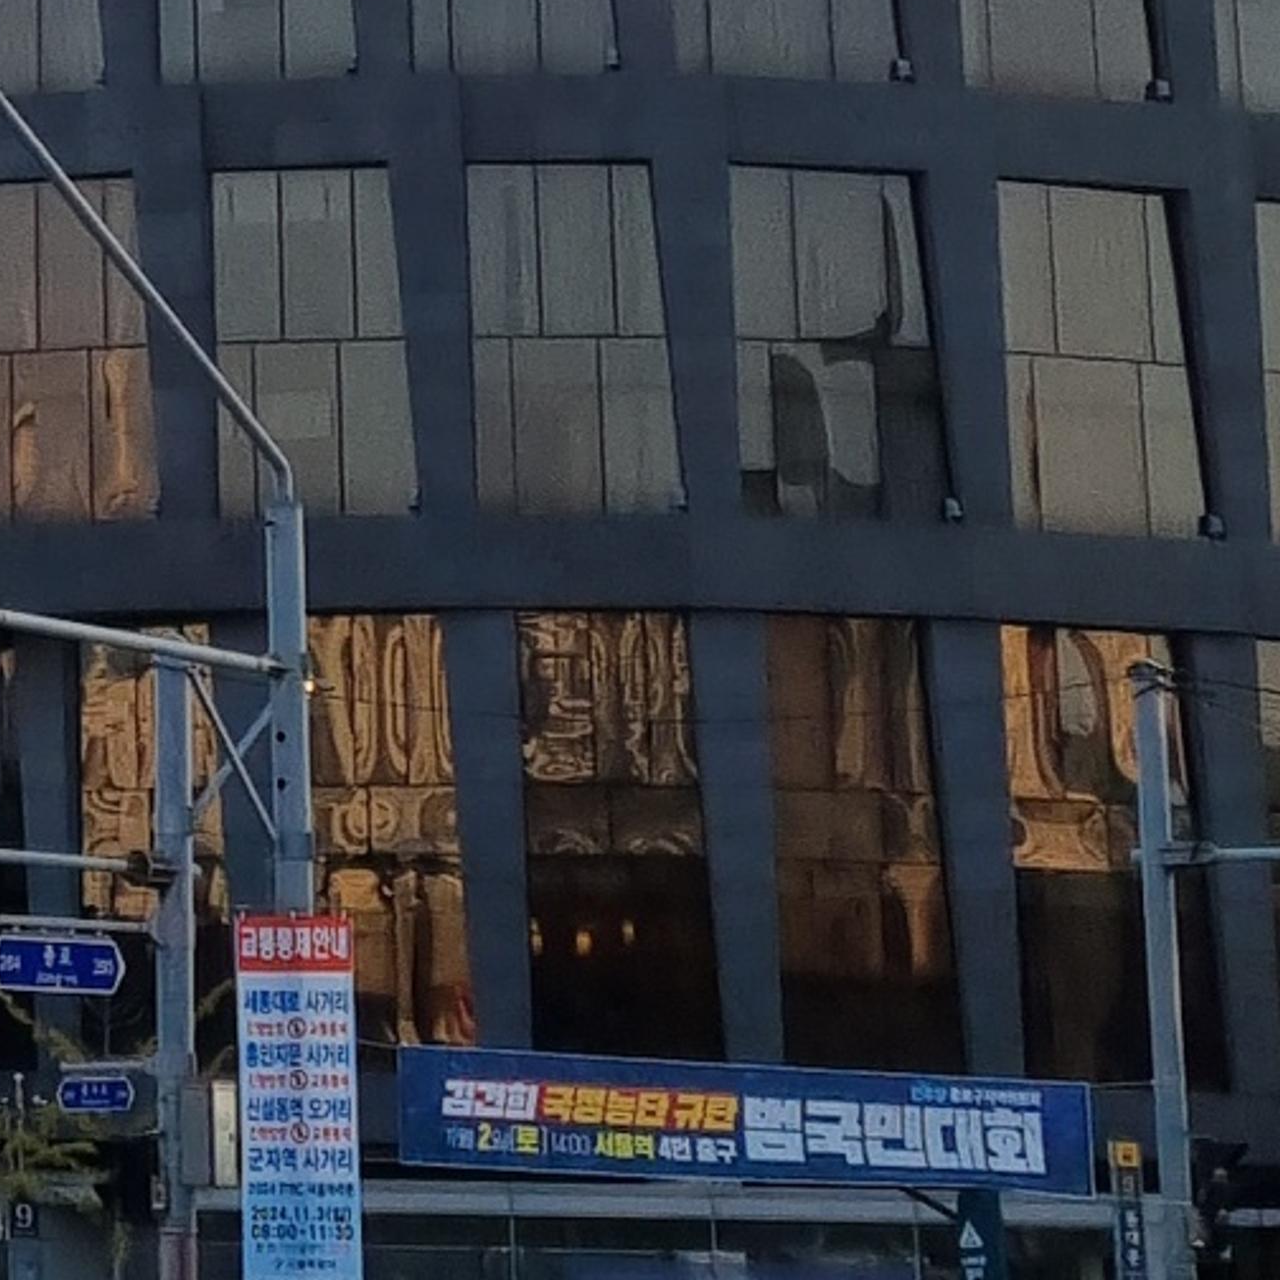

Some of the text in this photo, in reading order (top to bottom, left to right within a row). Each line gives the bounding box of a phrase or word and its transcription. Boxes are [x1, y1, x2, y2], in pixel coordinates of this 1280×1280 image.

[306, 989, 350, 1014] 사거리
[246, 1041, 350, 1068] 흥인지문 사거리
[248, 1097, 352, 1123] 신설동역 오거리
[442, 1079, 739, 1131] 김건희 국정농단 규탄
[594, 1131, 657, 1160] 서울역
[658, 1137, 693, 1161] 4번
[696, 1138, 738, 1164] 출구
[743, 1095, 1047, 1175] 범국민대회
[248, 1146, 353, 1174] 군자역 사거리
[16, 1203, 33, 1228] 9
